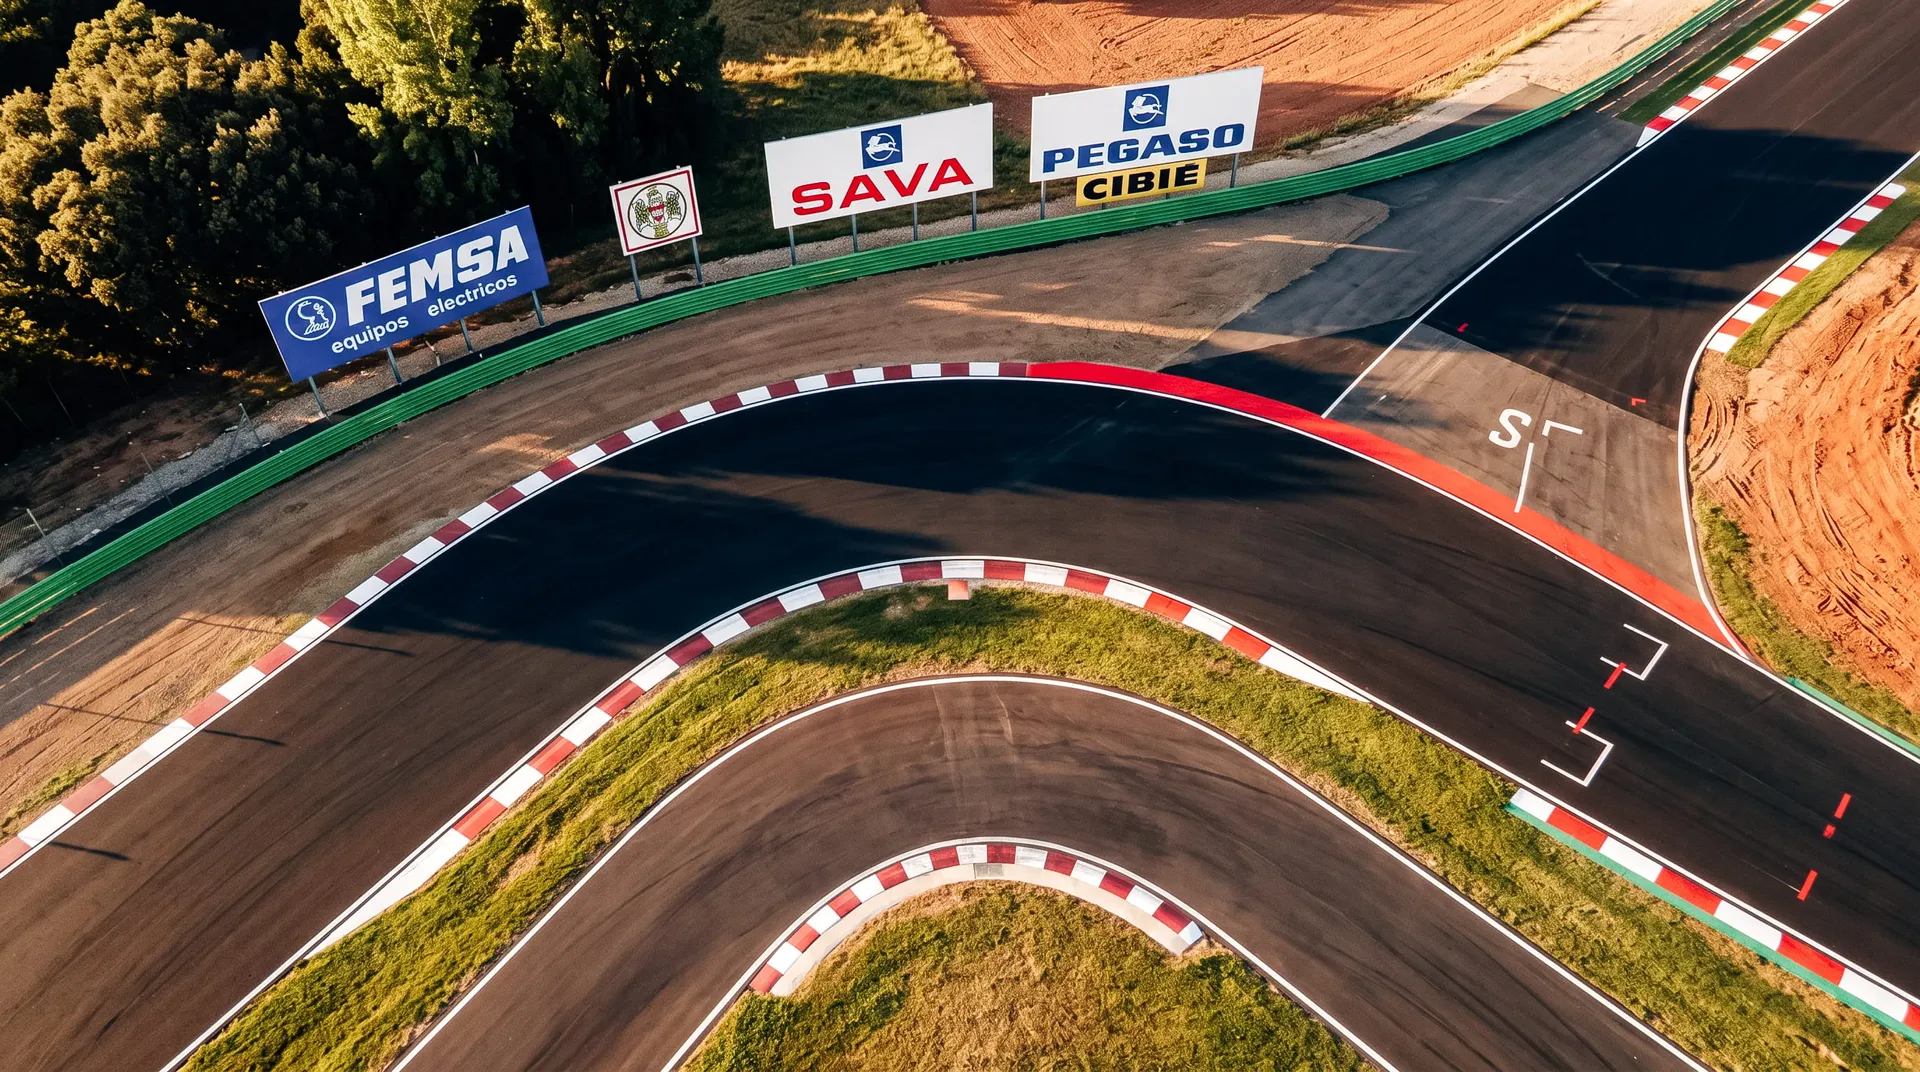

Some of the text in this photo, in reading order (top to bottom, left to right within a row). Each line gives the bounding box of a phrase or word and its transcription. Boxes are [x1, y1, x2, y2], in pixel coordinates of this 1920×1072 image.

[1042, 123, 1245, 174] PEGASO
[791, 157, 974, 216] SAVA
[1083, 162, 1200, 200] CIBIÉ
[345, 225, 530, 327] FEMSA
[331, 274, 518, 354] equipos electricos
